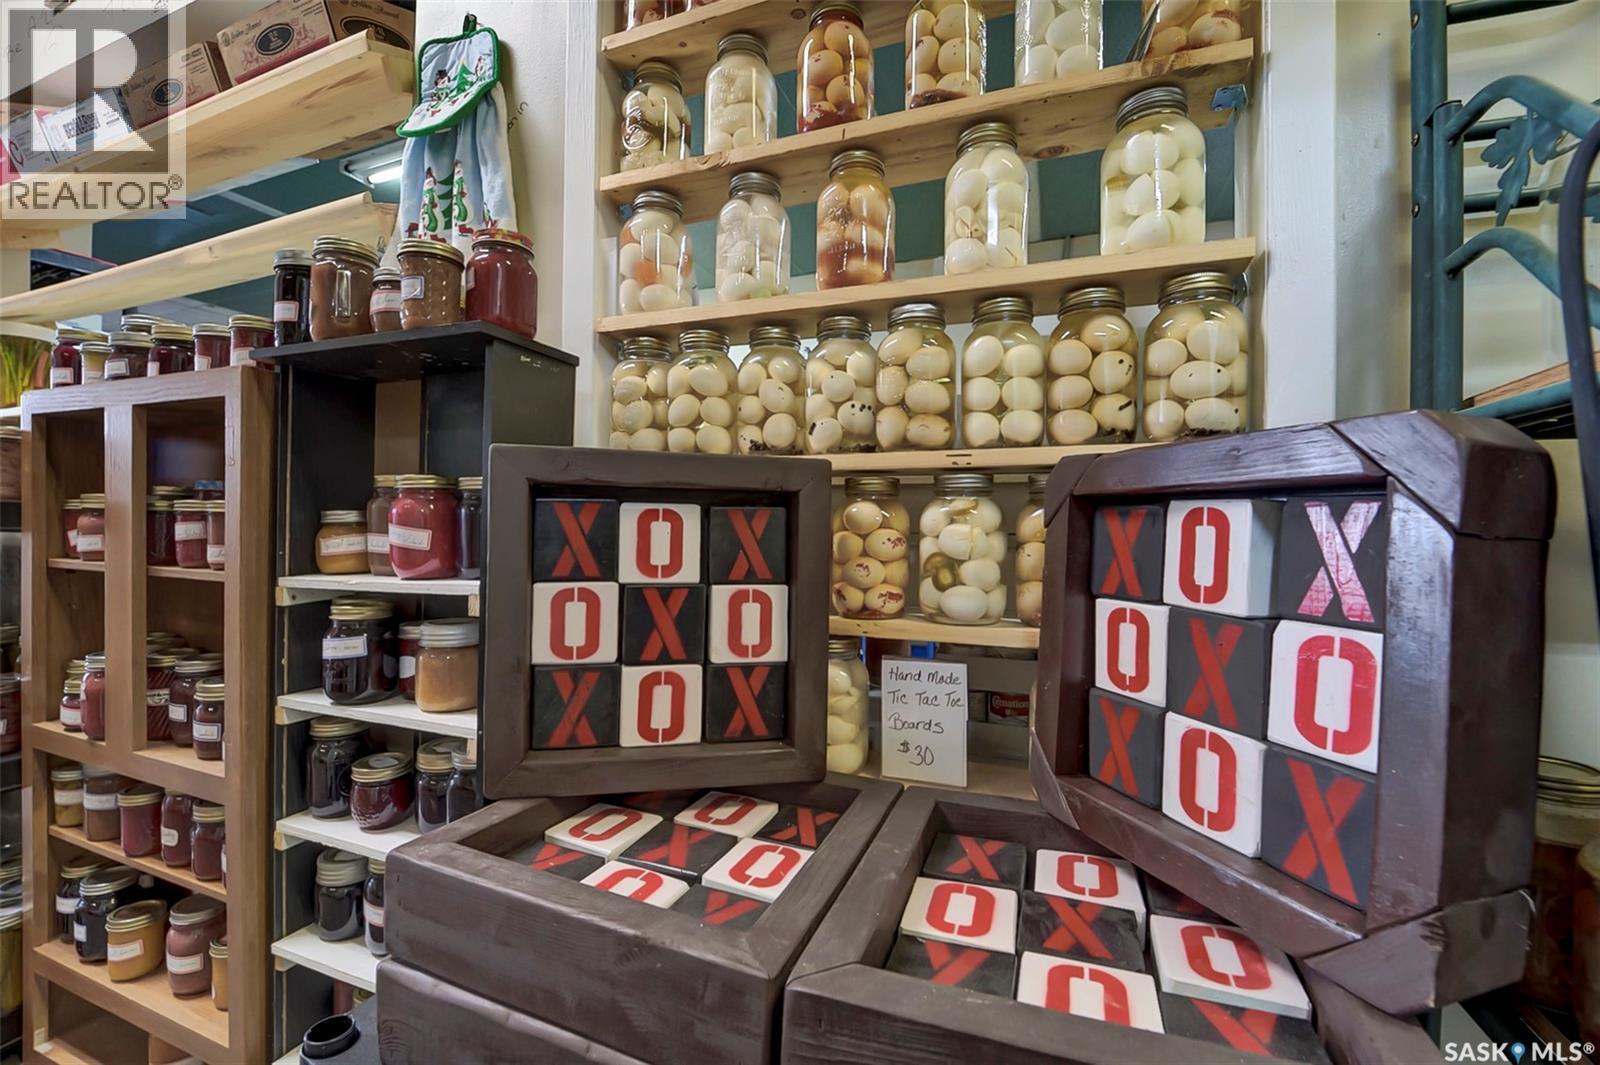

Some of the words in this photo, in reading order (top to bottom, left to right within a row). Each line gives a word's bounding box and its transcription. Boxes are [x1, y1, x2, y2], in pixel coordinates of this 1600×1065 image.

[552, 502, 604, 577] X
[635, 508, 684, 579] O
[727, 510, 773, 580] X
[1100, 508, 1147, 597] X
[1178, 506, 1231, 605] O
[1296, 501, 1382, 623] X
[549, 587, 602, 660] O
[639, 588, 690, 661] X
[727, 588, 773, 659] O
[548, 670, 601, 747] X
[636, 671, 686, 744] O
[723, 666, 770, 737] X
[887, 688, 909, 705] Tic
[914, 690, 941, 707] Tac
[944, 690, 966, 708] Toe
[888, 666, 923, 683] Hand
[927, 671, 963, 686] Made
[1106, 607, 1151, 694] O
[1183, 617, 1244, 729] X
[1293, 634, 1378, 756] O
[888, 711, 945, 734] Boards
[693, 795, 758, 826] O
[768, 807, 840, 847] X
[1095, 697, 1141, 798] X
[1179, 727, 1238, 833] O
[1281, 757, 1366, 905] X
[567, 807, 643, 843] O
[636, 824, 716, 868] X
[728, 843, 802, 889] O
[945, 835, 1007, 881] X
[1055, 853, 1119, 898] O
[925, 883, 996, 936] O
[1040, 896, 1114, 960] X
[1180, 924, 1273, 991] O
